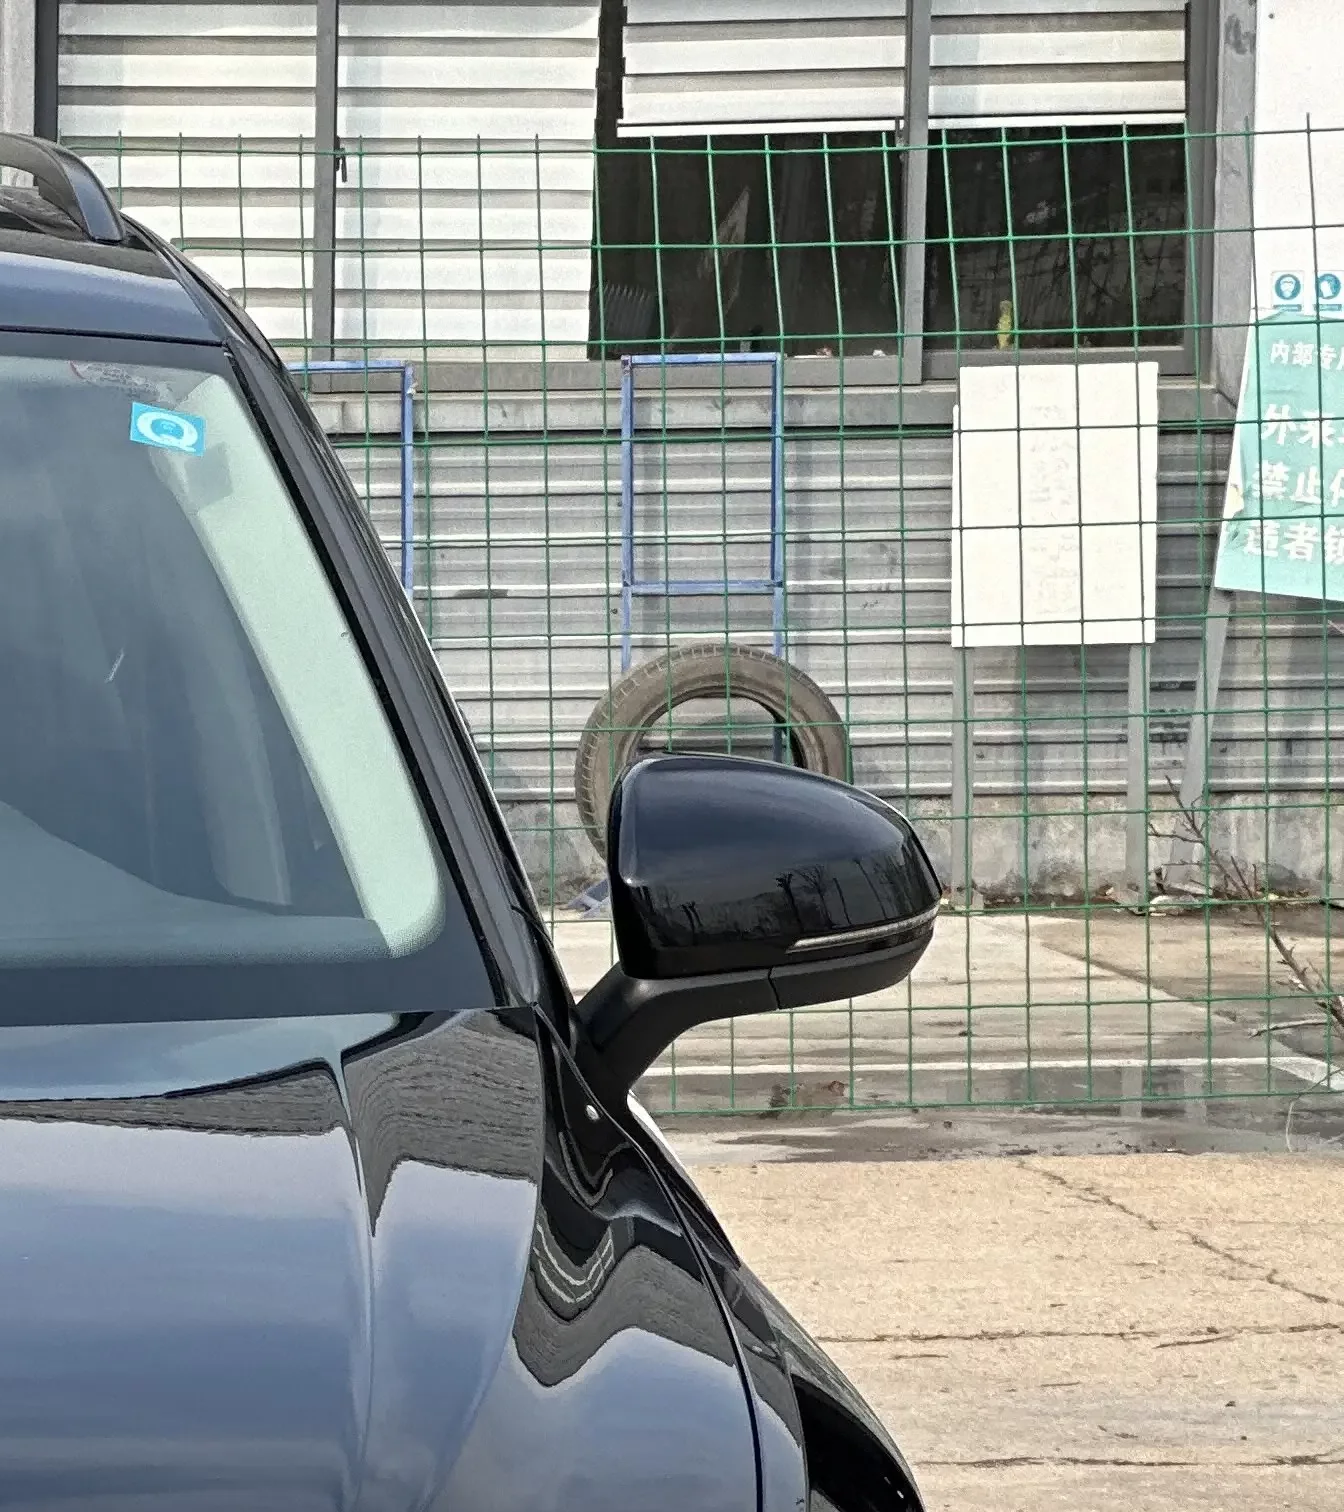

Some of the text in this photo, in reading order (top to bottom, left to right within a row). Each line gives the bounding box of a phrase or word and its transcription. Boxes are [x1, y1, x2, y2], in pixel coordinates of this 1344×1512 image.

[1270, 339, 1344, 370] 内部专
[1261, 403, 1344, 449] 外来
